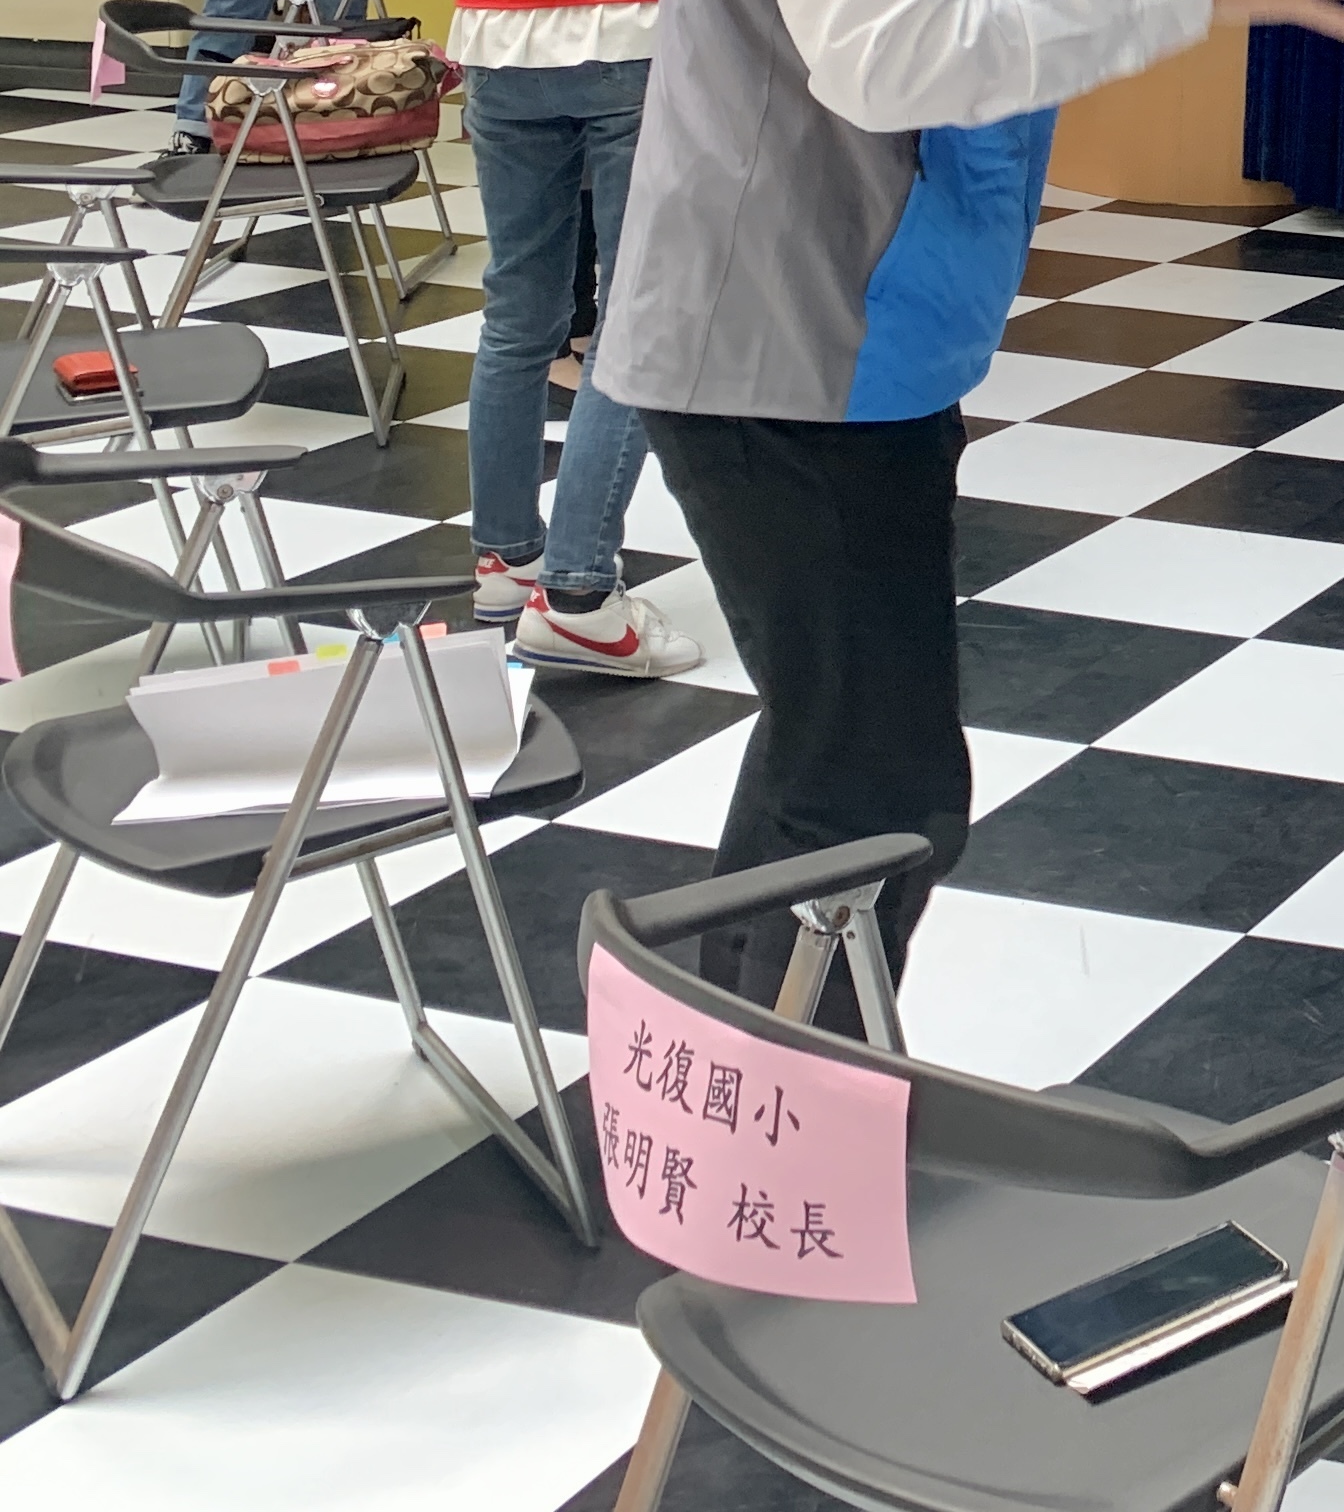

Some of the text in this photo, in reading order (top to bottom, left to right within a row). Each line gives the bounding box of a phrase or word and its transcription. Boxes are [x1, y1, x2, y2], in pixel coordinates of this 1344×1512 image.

[623, 1018, 801, 1147] 光復國小
[601, 1102, 844, 1260] 張明賢 校長
